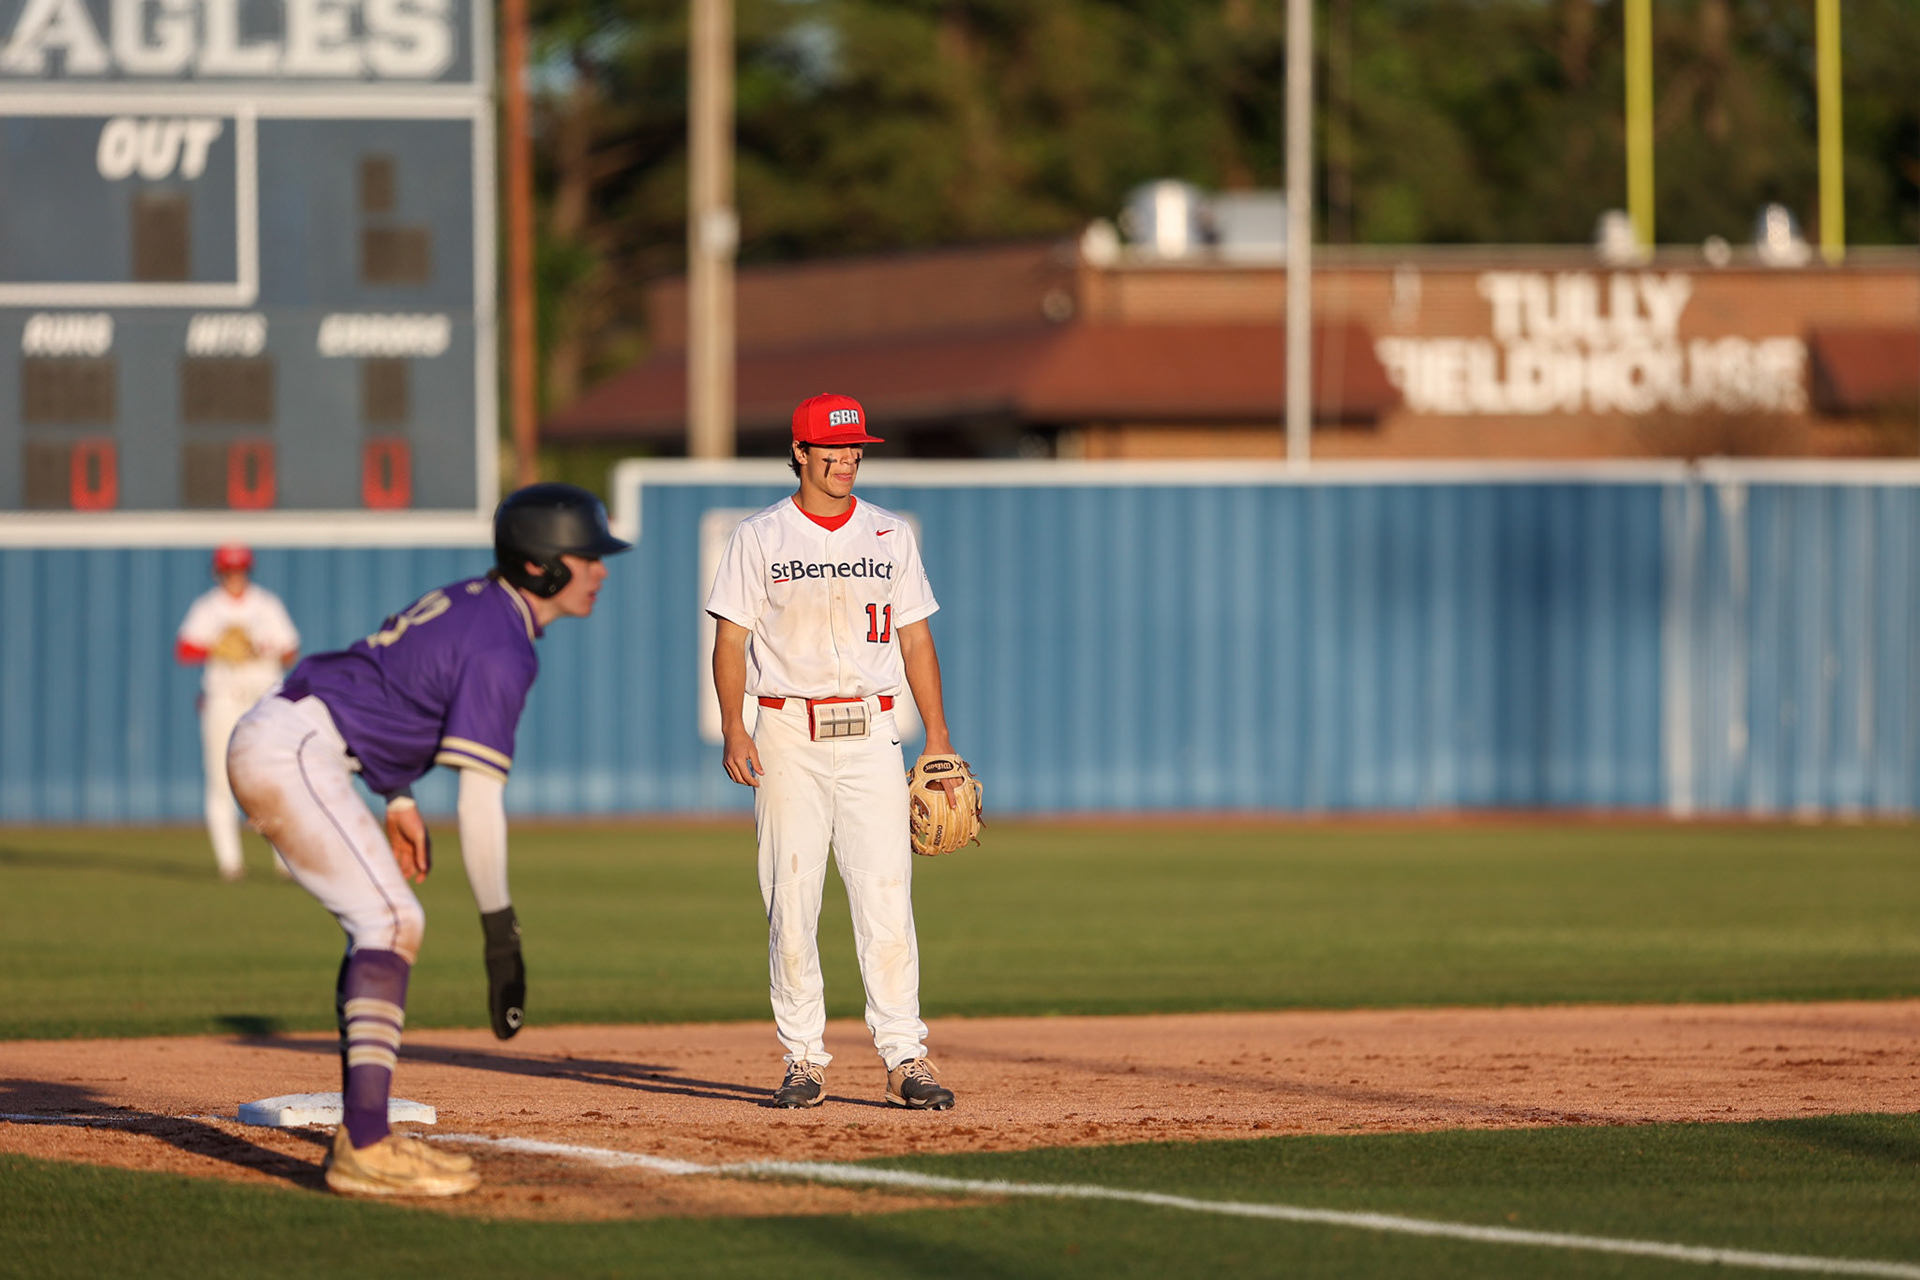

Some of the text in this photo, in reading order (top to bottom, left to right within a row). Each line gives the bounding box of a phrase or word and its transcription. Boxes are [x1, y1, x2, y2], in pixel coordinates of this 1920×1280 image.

[97, 118, 221, 180] OUT
[1479, 272, 1692, 338] TULLY
[829, 409, 860, 427] SBA
[865, 603, 891, 643] 11
